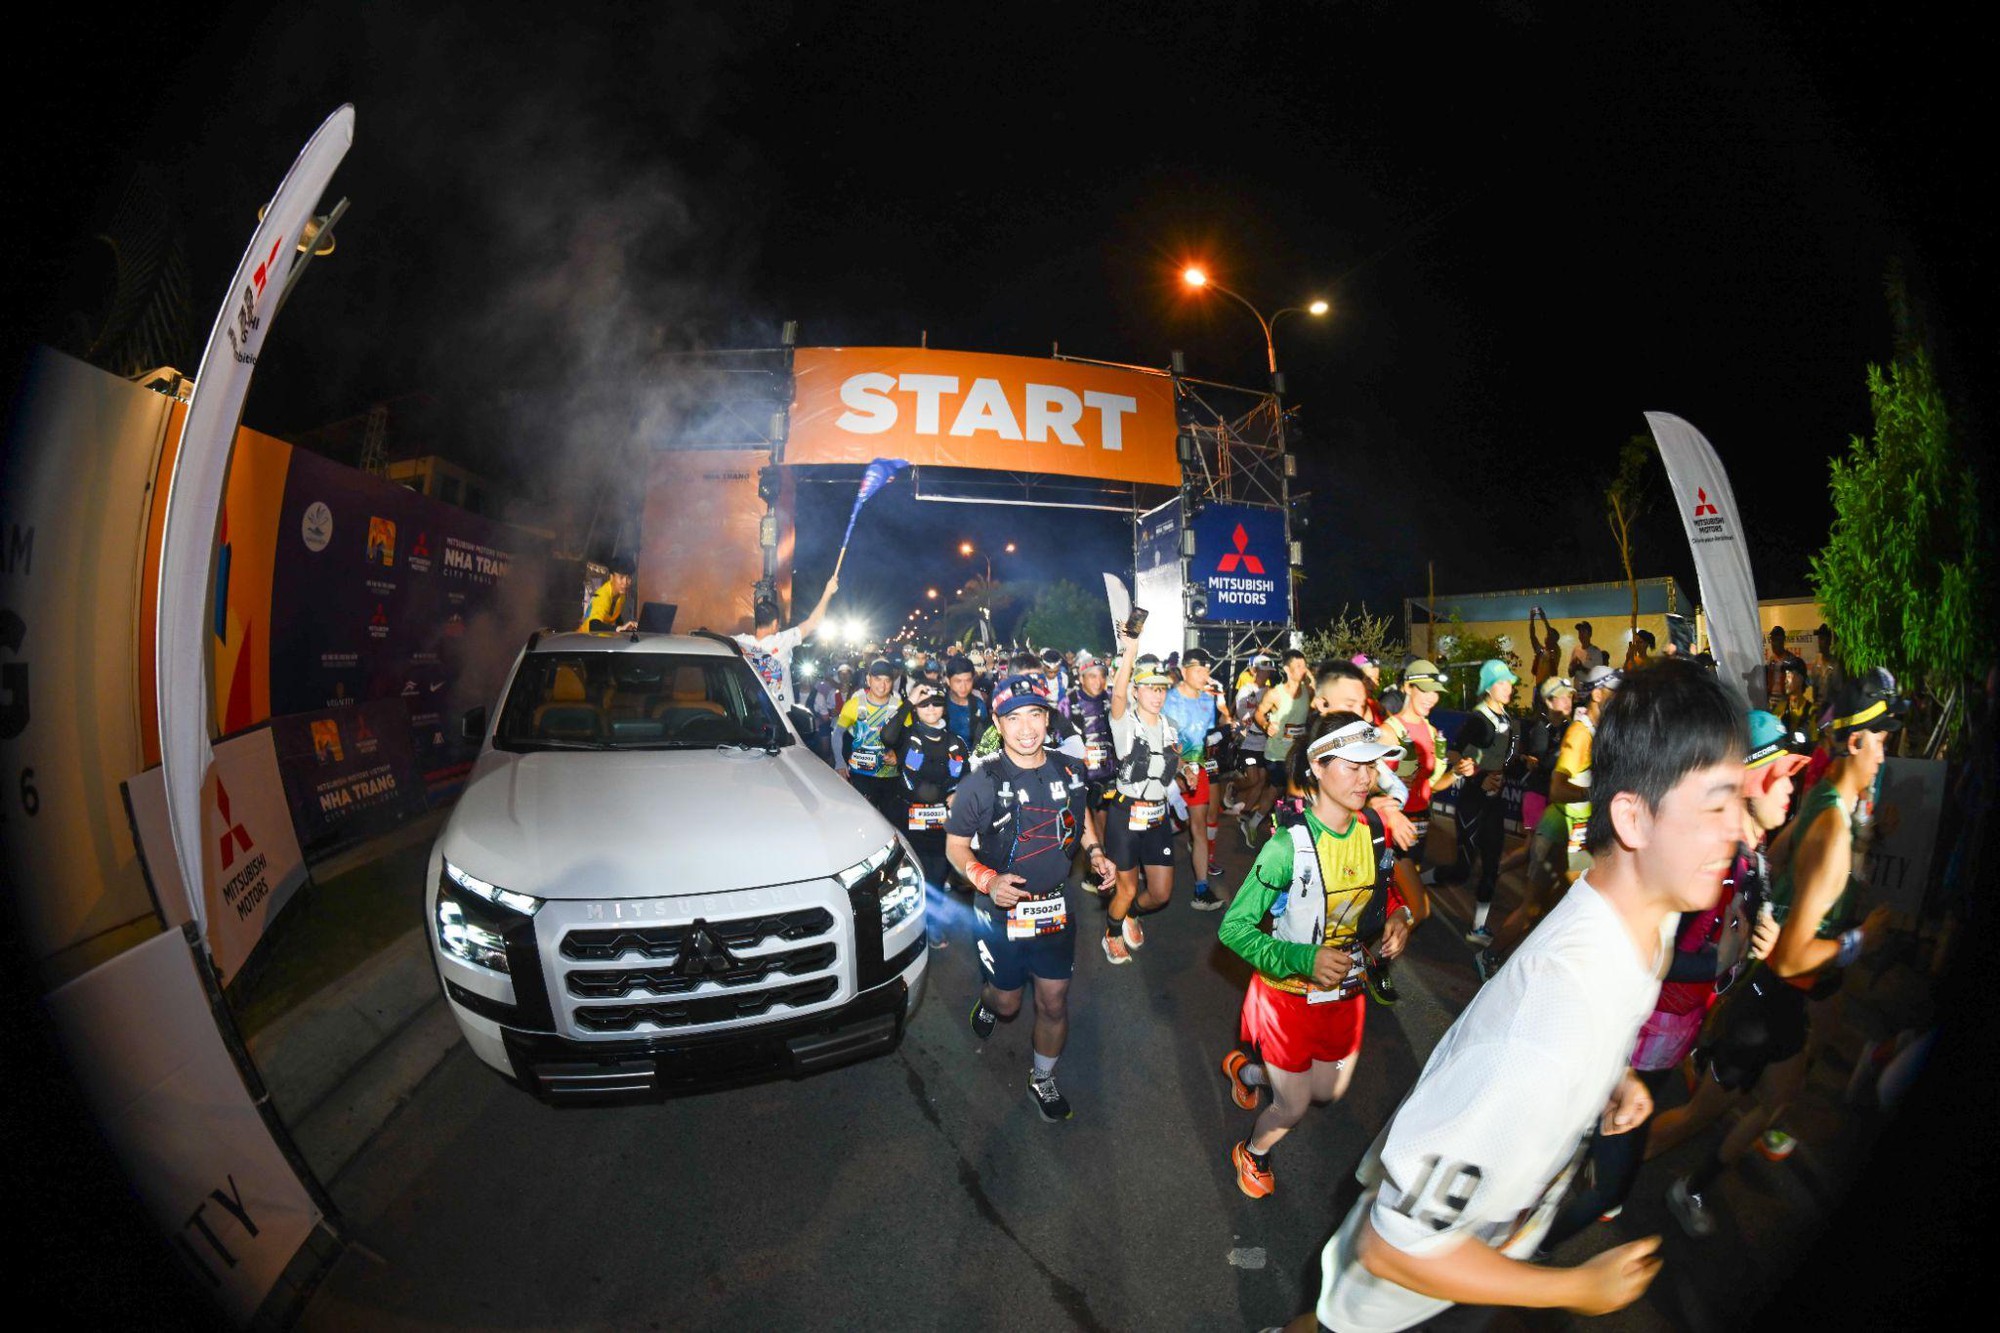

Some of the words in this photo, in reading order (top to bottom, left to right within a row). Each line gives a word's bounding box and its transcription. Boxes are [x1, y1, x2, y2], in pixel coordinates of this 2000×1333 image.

[835, 372, 1137, 451] START
[1699, 525, 1722, 533] MOTORS
[443, 547, 472, 571] NHA
[475, 555, 508, 577] TRAN
[1208, 576, 1274, 592] MITSUBISHI
[1218, 592, 1267, 605] MOTORS
[319, 787, 352, 811] NHA
[353, 773, 396, 799] TRANG
[222, 852, 267, 906] MITSUBISHI
[236, 877, 269, 921] MOTORS
[586, 887, 803, 920] MITSUBISHI
[1023, 903, 1062, 915] F350247
